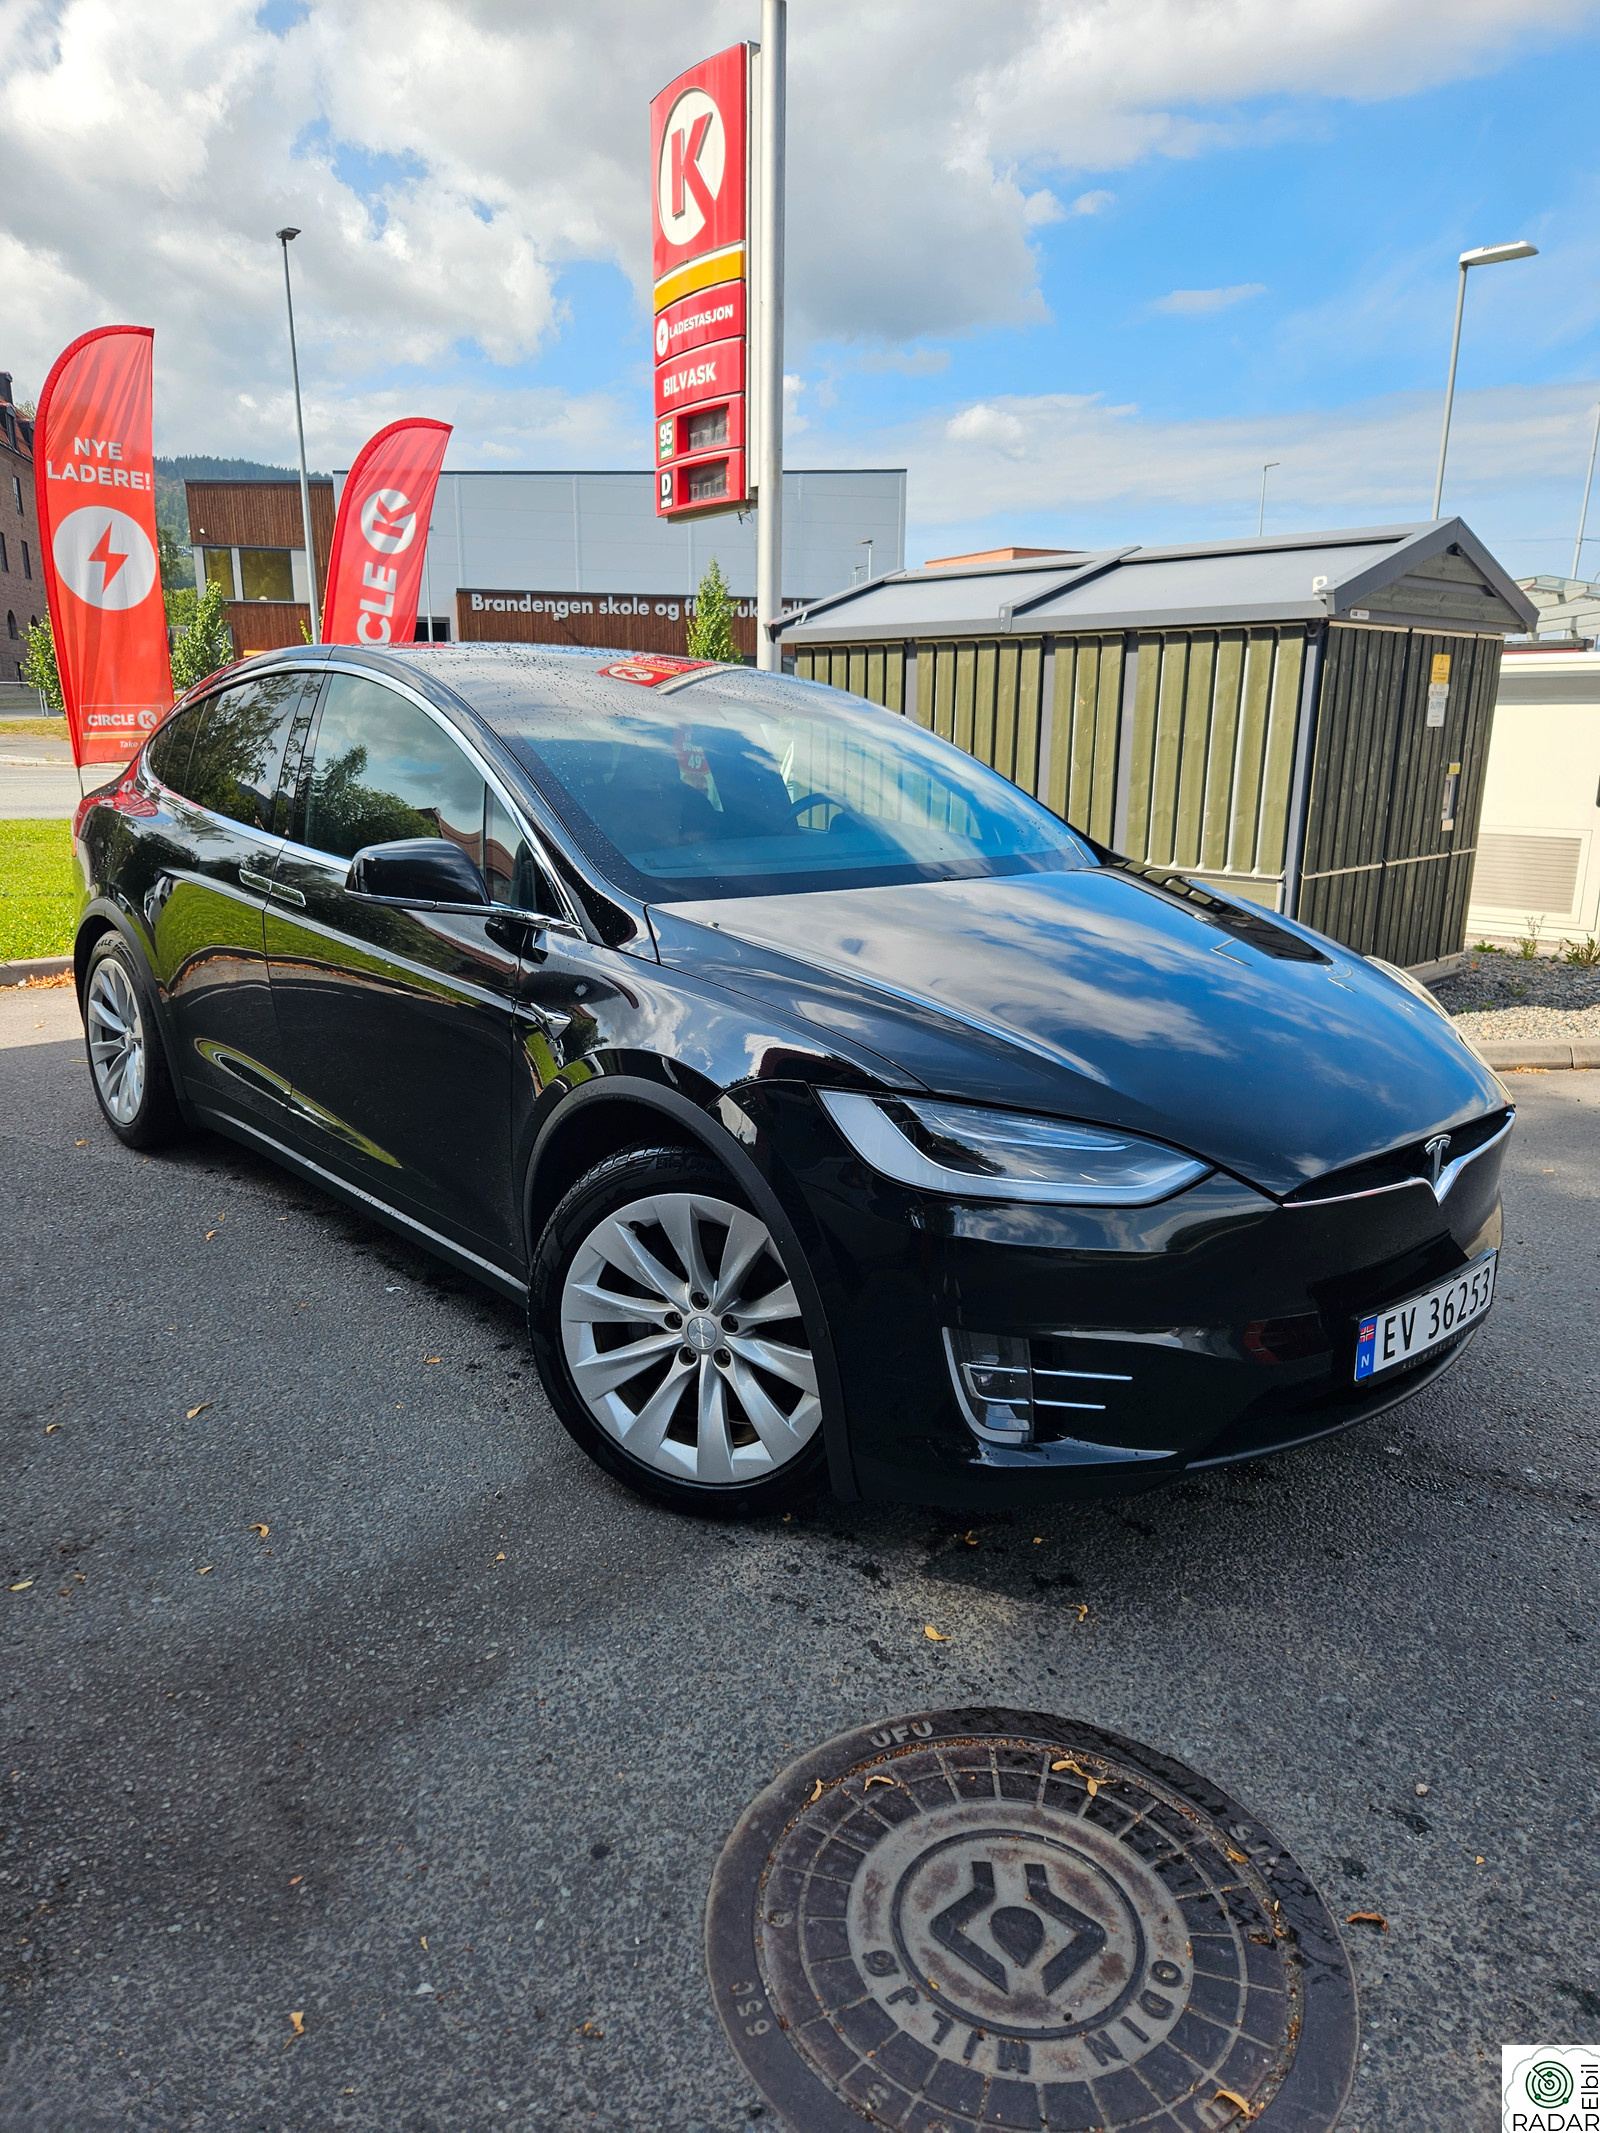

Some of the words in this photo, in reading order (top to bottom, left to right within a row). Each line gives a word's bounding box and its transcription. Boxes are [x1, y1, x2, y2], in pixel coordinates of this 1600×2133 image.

[669, 304, 734, 339] LADESTASJON
[663, 362, 717, 397] BILVASK
[660, 421, 673, 447] 95
[74, 437, 123, 461] NYE
[46, 460, 151, 491] LADERE!
[661, 474, 672, 497] D
[471, 593, 593, 619] Brandengen
[599, 596, 650, 616] skole
[655, 602, 680, 621] og
[87, 714, 135, 727] CIRCLE
[120, 740, 138, 748] Take
[1361, 1354, 1370, 1368] N
[1383, 1307, 1416, 1361] EV
[1428, 1267, 1491, 1340] 36253
[868, 1721, 933, 1748] UFU
[862, 1950, 1031, 2075] MILJØ
[1084, 1959, 1184, 2066] ODIN
